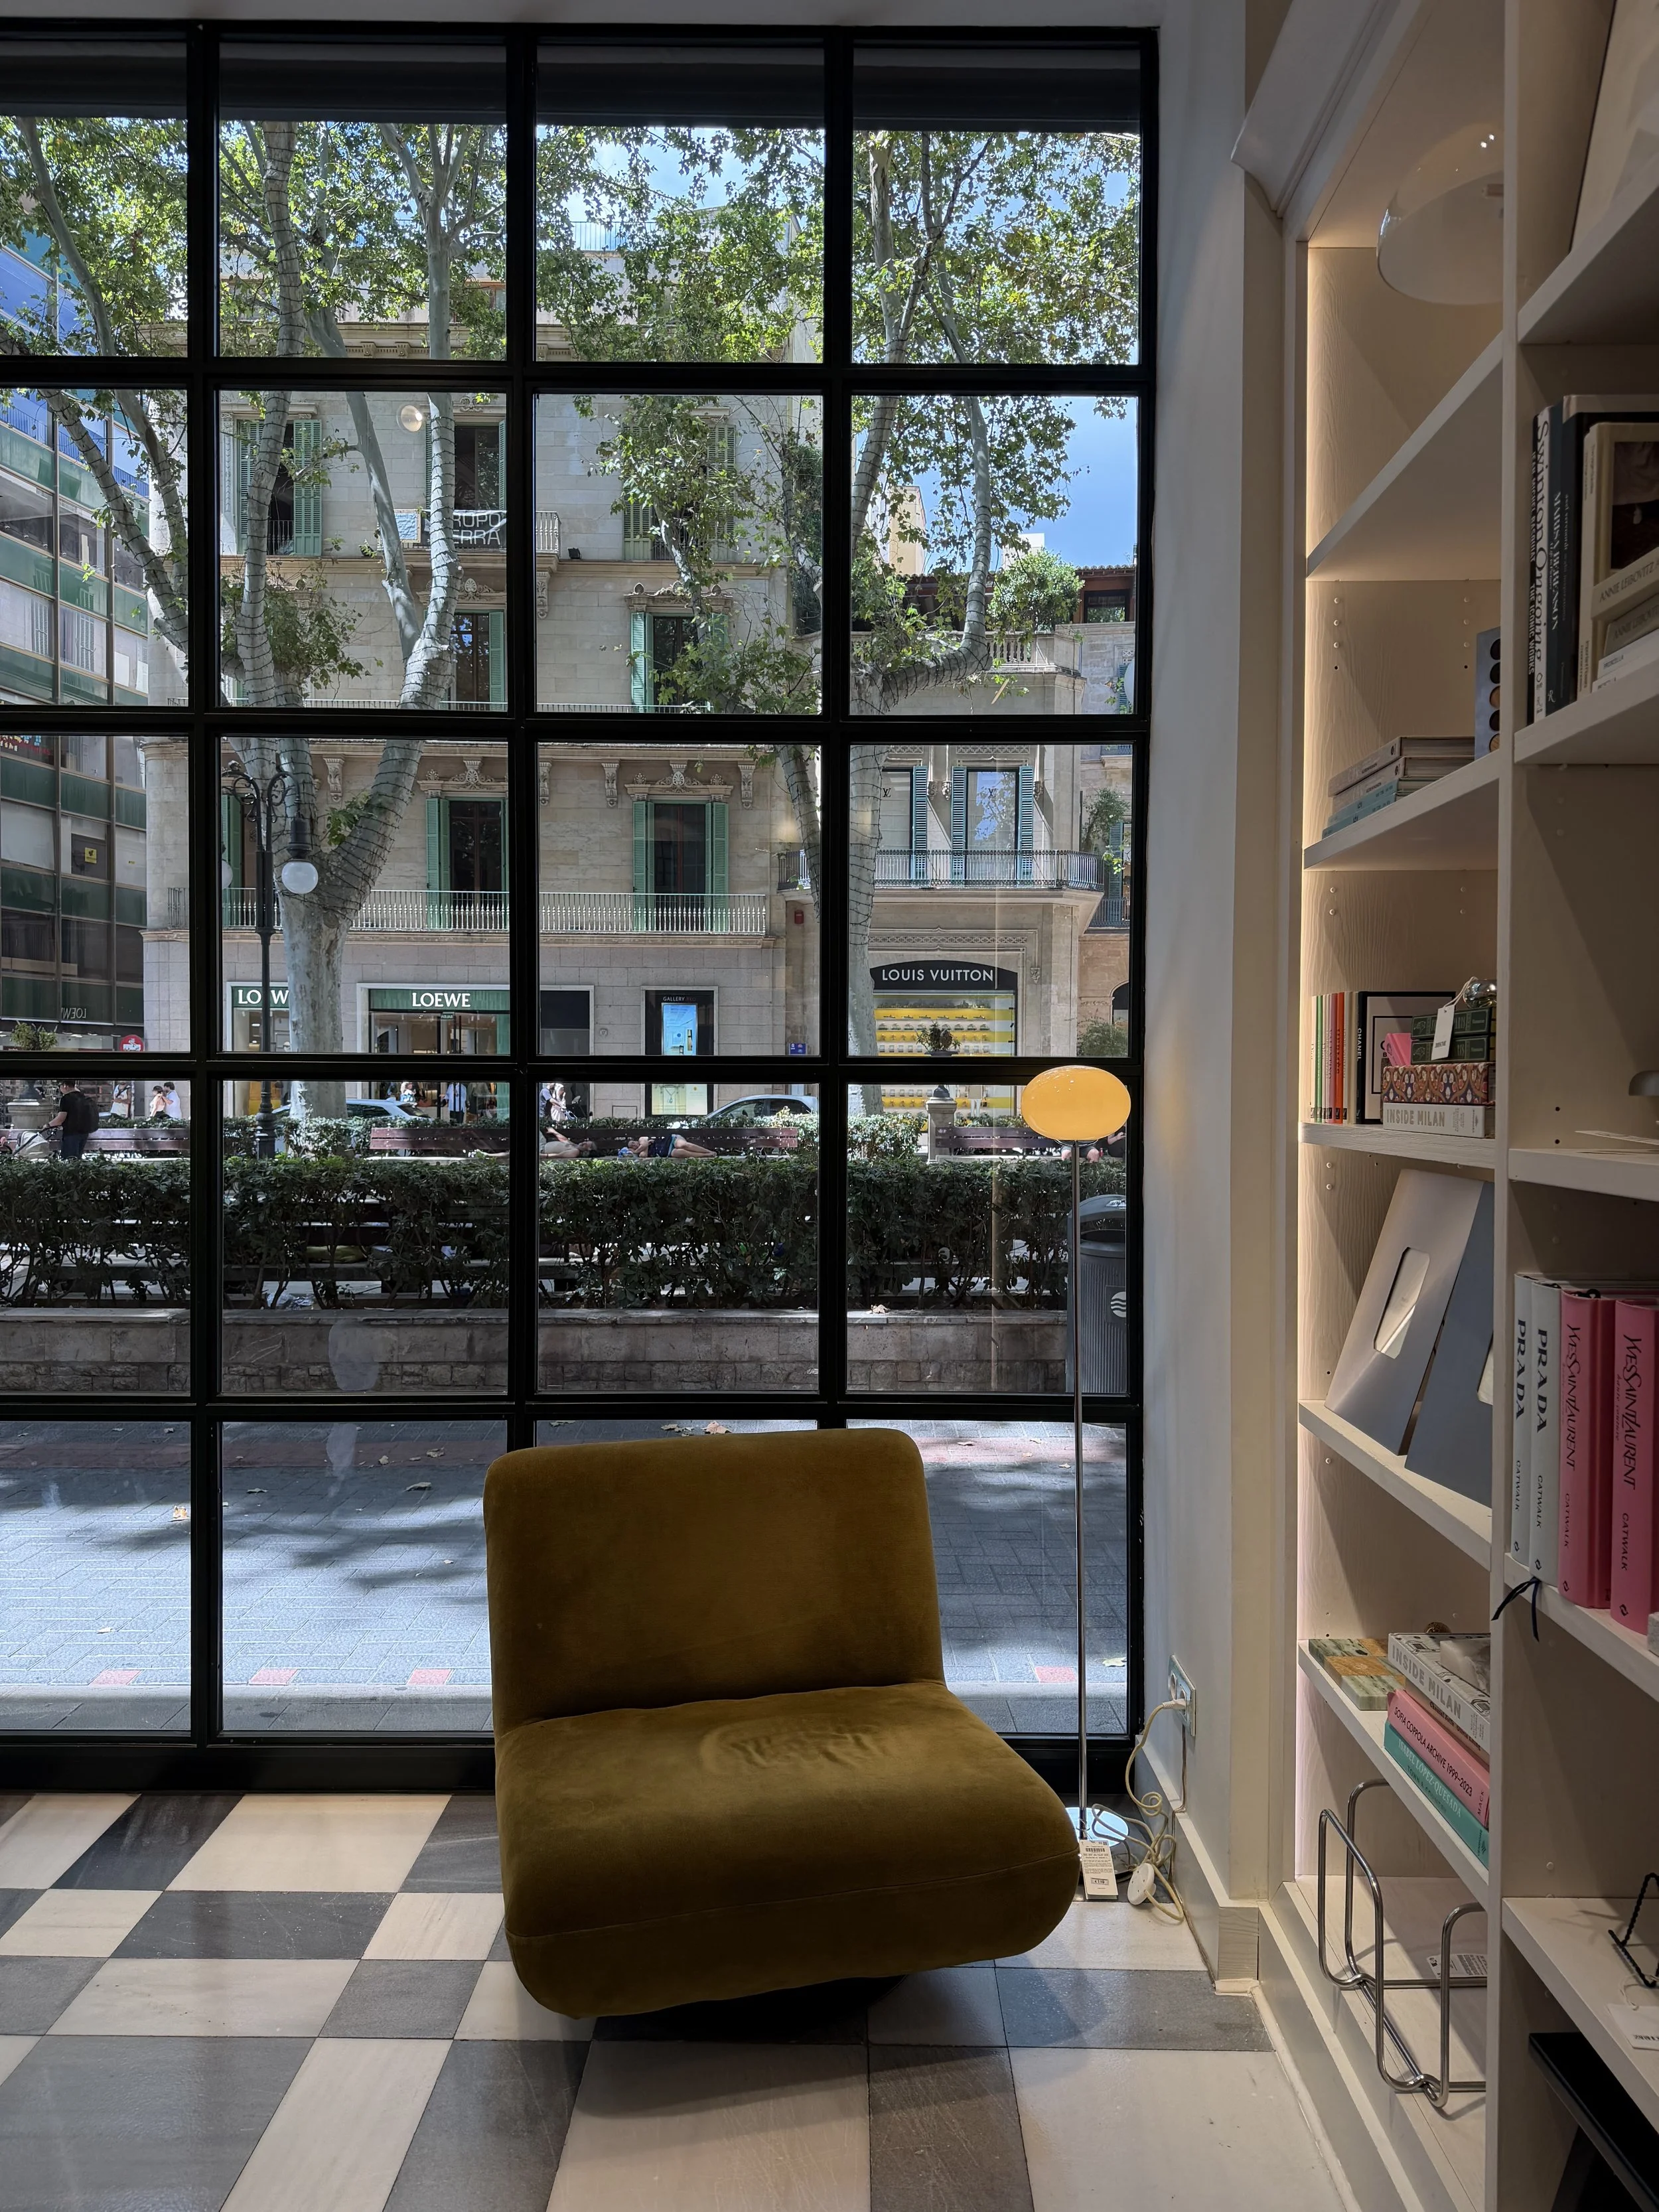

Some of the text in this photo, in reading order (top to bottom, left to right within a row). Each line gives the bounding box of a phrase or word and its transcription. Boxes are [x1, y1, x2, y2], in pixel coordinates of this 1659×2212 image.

[882, 969, 993, 982] LOUIS VUITTON
[238, 990, 289, 1005] LOW
[411, 992, 471, 1007] LOEWE
[1386, 1108, 1415, 1126] INSIDE
[1417, 1110, 1445, 1128] MILAN
[1515, 1318, 1526, 1421] PRADA
[1536, 1328, 1548, 1434] PRADA
[1392, 1645, 1462, 1720] INSIDE MILAN
[1394, 1706, 1406, 1726] SOFIA
[1406, 1720, 1427, 1749] COPPOLA
[1426, 1741, 1447, 1769] ARCHIVE
[1398, 1737, 1416, 1766] ISABEL
